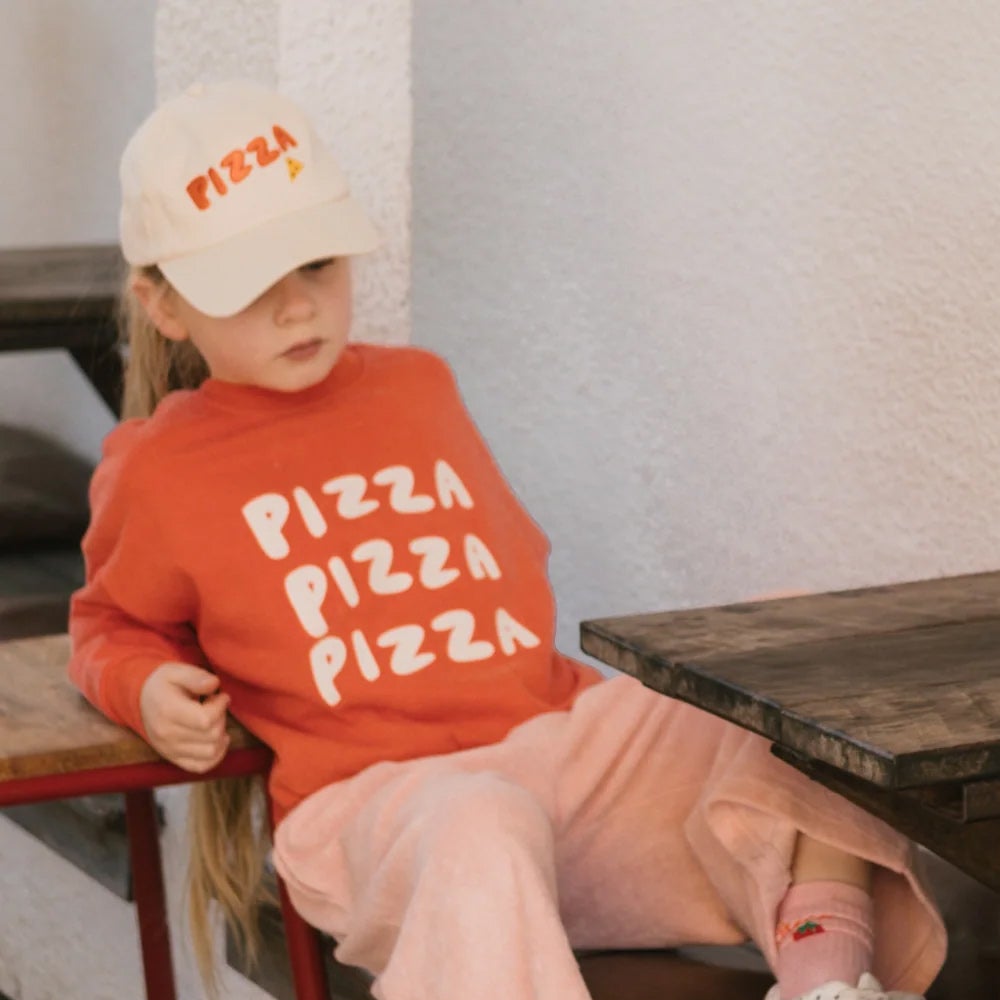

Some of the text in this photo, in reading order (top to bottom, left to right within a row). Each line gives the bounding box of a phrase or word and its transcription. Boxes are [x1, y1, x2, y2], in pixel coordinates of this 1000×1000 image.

[185, 124, 298, 212] PIZZA
[241, 459, 474, 560] PIZZA
[284, 533, 502, 639] PIZZA
[309, 607, 541, 707] PIZZA
